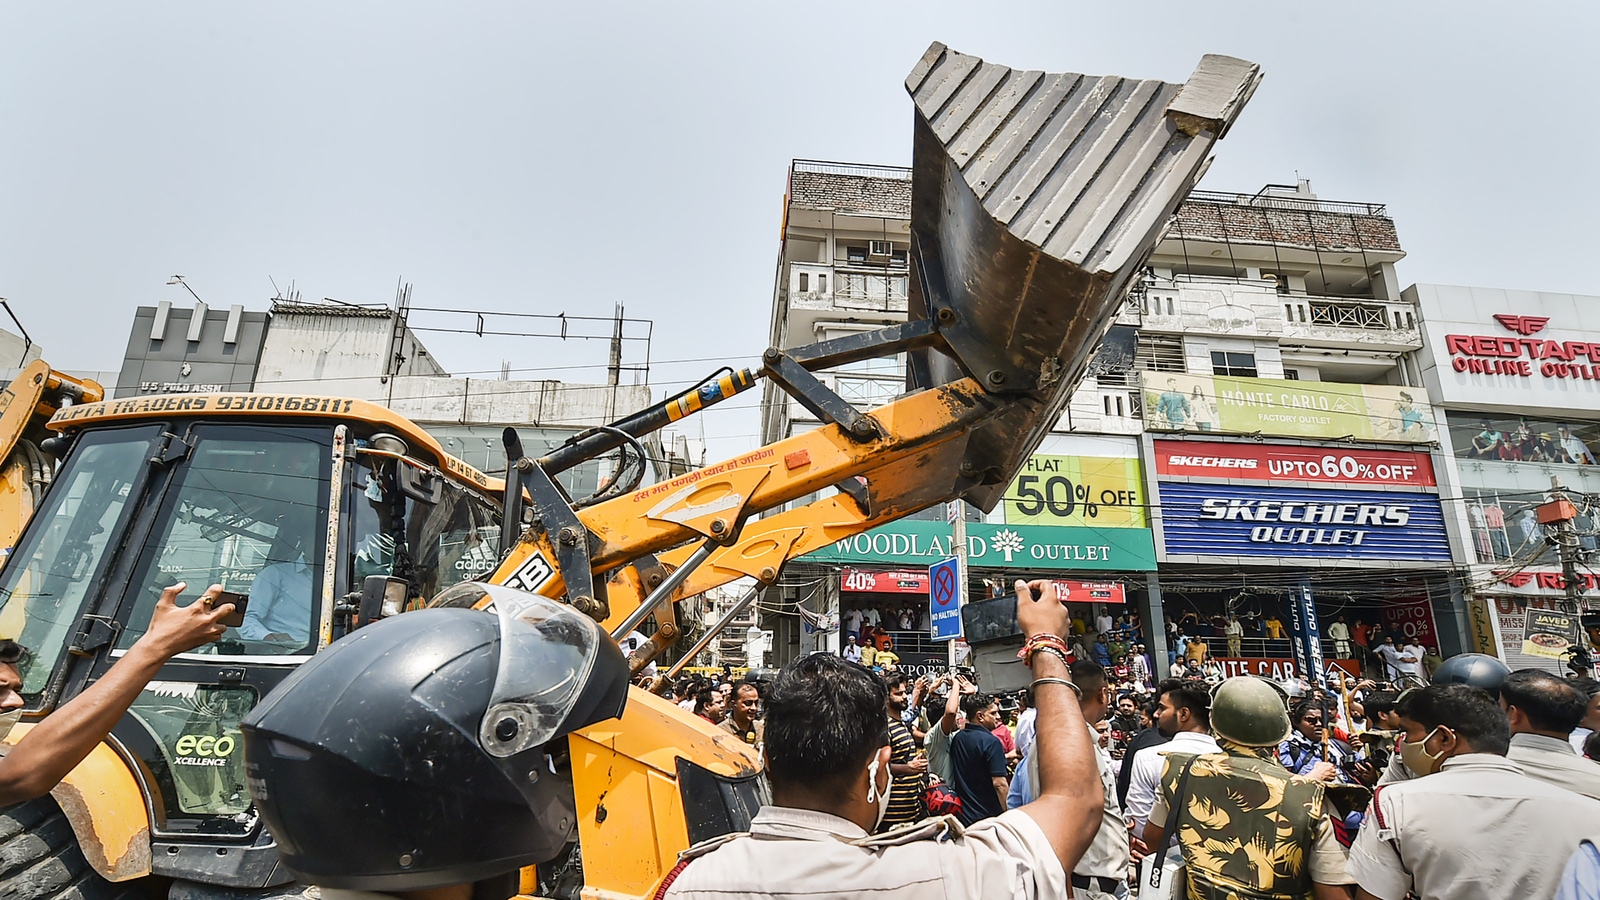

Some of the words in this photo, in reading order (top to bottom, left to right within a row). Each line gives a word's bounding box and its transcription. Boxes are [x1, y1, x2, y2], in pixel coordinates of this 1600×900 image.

[1453, 357, 1532, 376] ONLINE
[1541, 362, 1600, 380] OUTLE
[162, 382, 191, 393] POLO
[191, 384, 223, 394] ASSN
[112, 396, 210, 416] TRADERS
[215, 396, 353, 413] 9310168111
[1221, 389, 1273, 408] MONTE
[1281, 394, 1329, 411] CARLO
[1258, 413, 1297, 424] FACTORY
[1298, 415, 1331, 425] OUTLET
[1027, 458, 1060, 472] FLAT
[1168, 455, 1258, 469] SKECHERS
[652, 482, 670, 495] मत
[671, 471, 702, 488] पगली
[727, 456, 740, 472] हो
[1016, 475, 1098, 518] 50%
[1100, 489, 1136, 505] OFF
[1200, 498, 1411, 526] SKECHERS
[1250, 526, 1369, 546] OUTLET
[1031, 544, 1111, 561] OUTLET
[845, 572, 876, 590] 40%
[932, 613, 938, 621] NO
[939, 609, 958, 620] HALTING
[1290, 589, 1300, 631] OUTLET
[1303, 585, 1316, 631] OUTLET
[1386, 606, 1425, 620] UPTO
[1536, 615, 1570, 626] JAVED
[175, 735, 235, 757] eco
[173, 757, 227, 767] XCELLENCE
